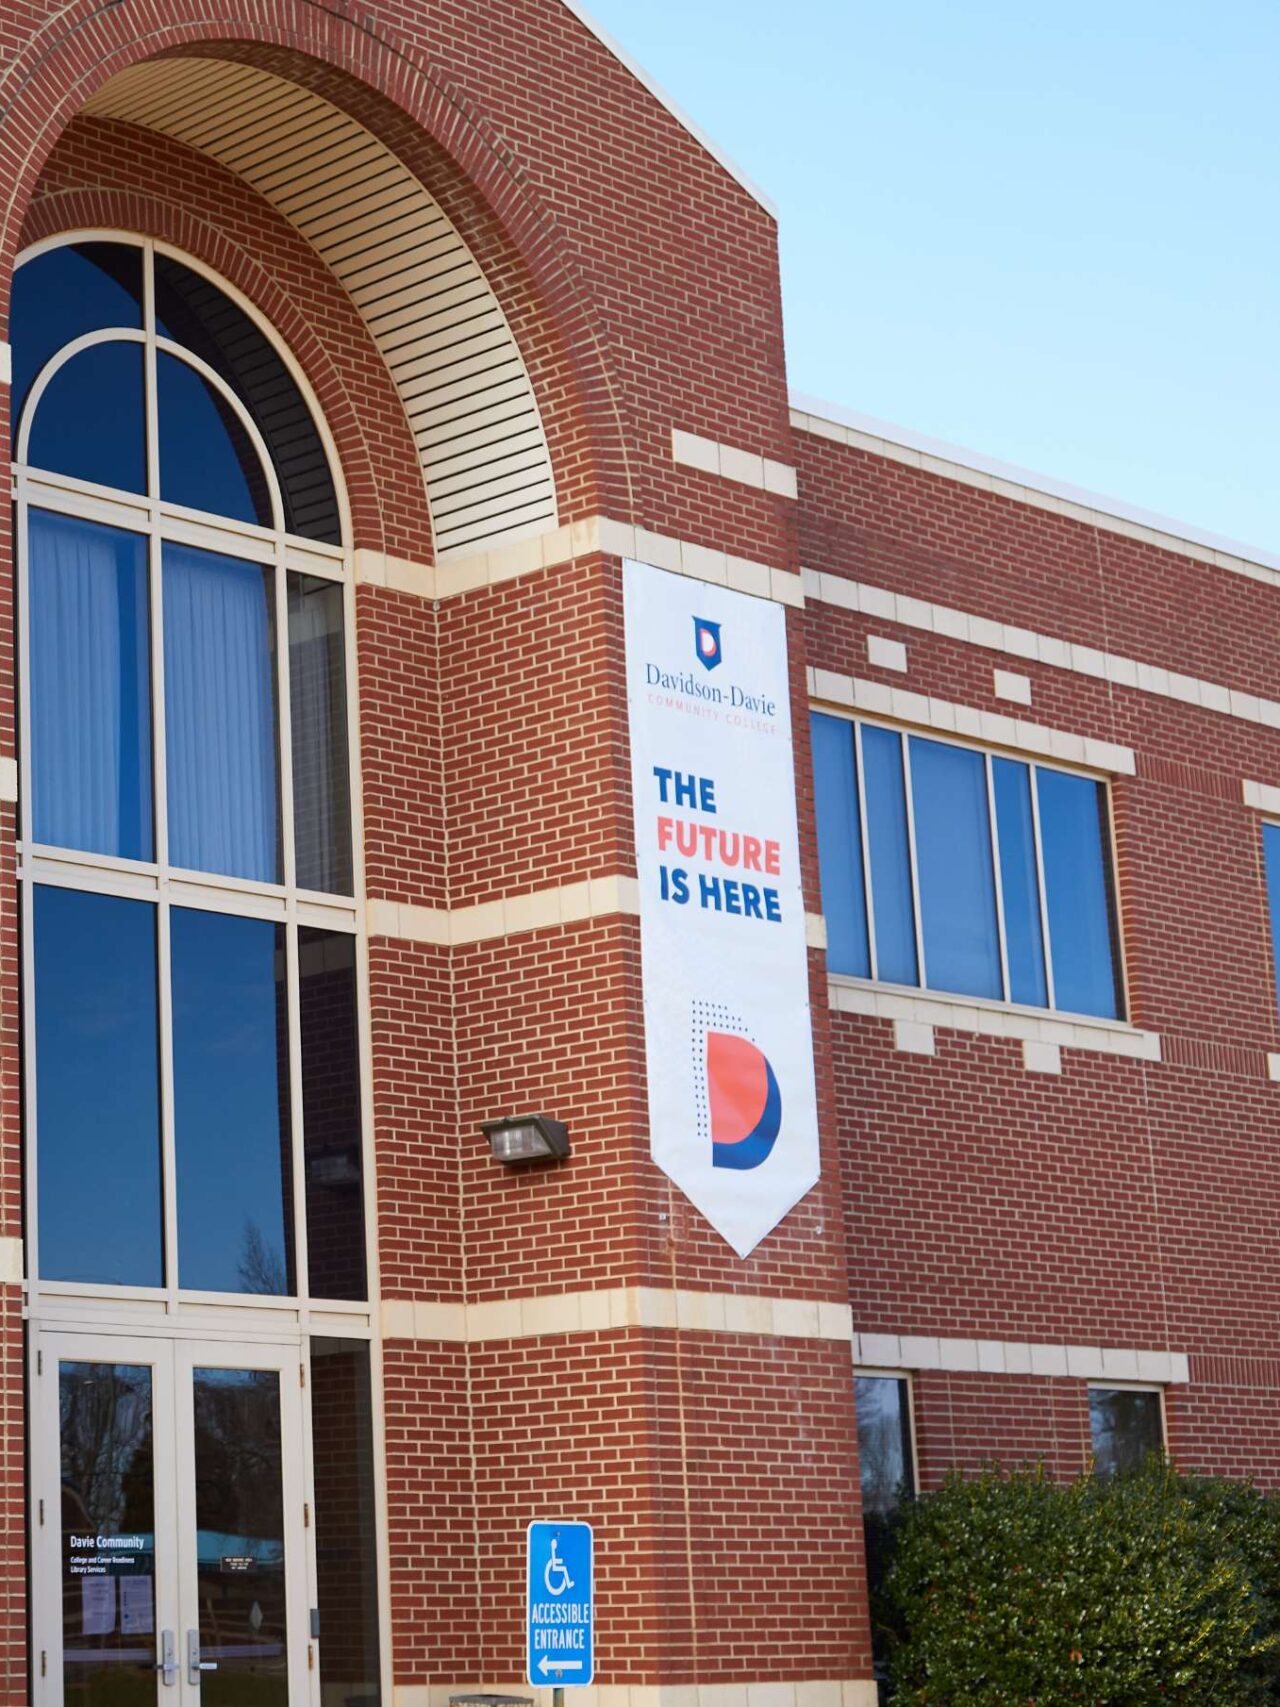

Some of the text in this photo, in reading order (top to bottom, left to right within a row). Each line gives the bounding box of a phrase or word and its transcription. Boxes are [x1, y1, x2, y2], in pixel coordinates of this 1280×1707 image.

[645, 663, 776, 716] Davidson-Davie
[647, 693, 777, 735] COMMUNITY COLLEGE
[653, 766, 717, 814] THE
[657, 816, 781, 876] FUTURE
[659, 865, 782, 923] IS HERE
[70, 1535, 145, 1550] Davie Community
[70, 1556, 88, 1565] College
[70, 1566, 87, 1574] Library
[531, 1603, 590, 1624] ACCESSIBLE
[534, 1628, 585, 1649] ENTRANCE
